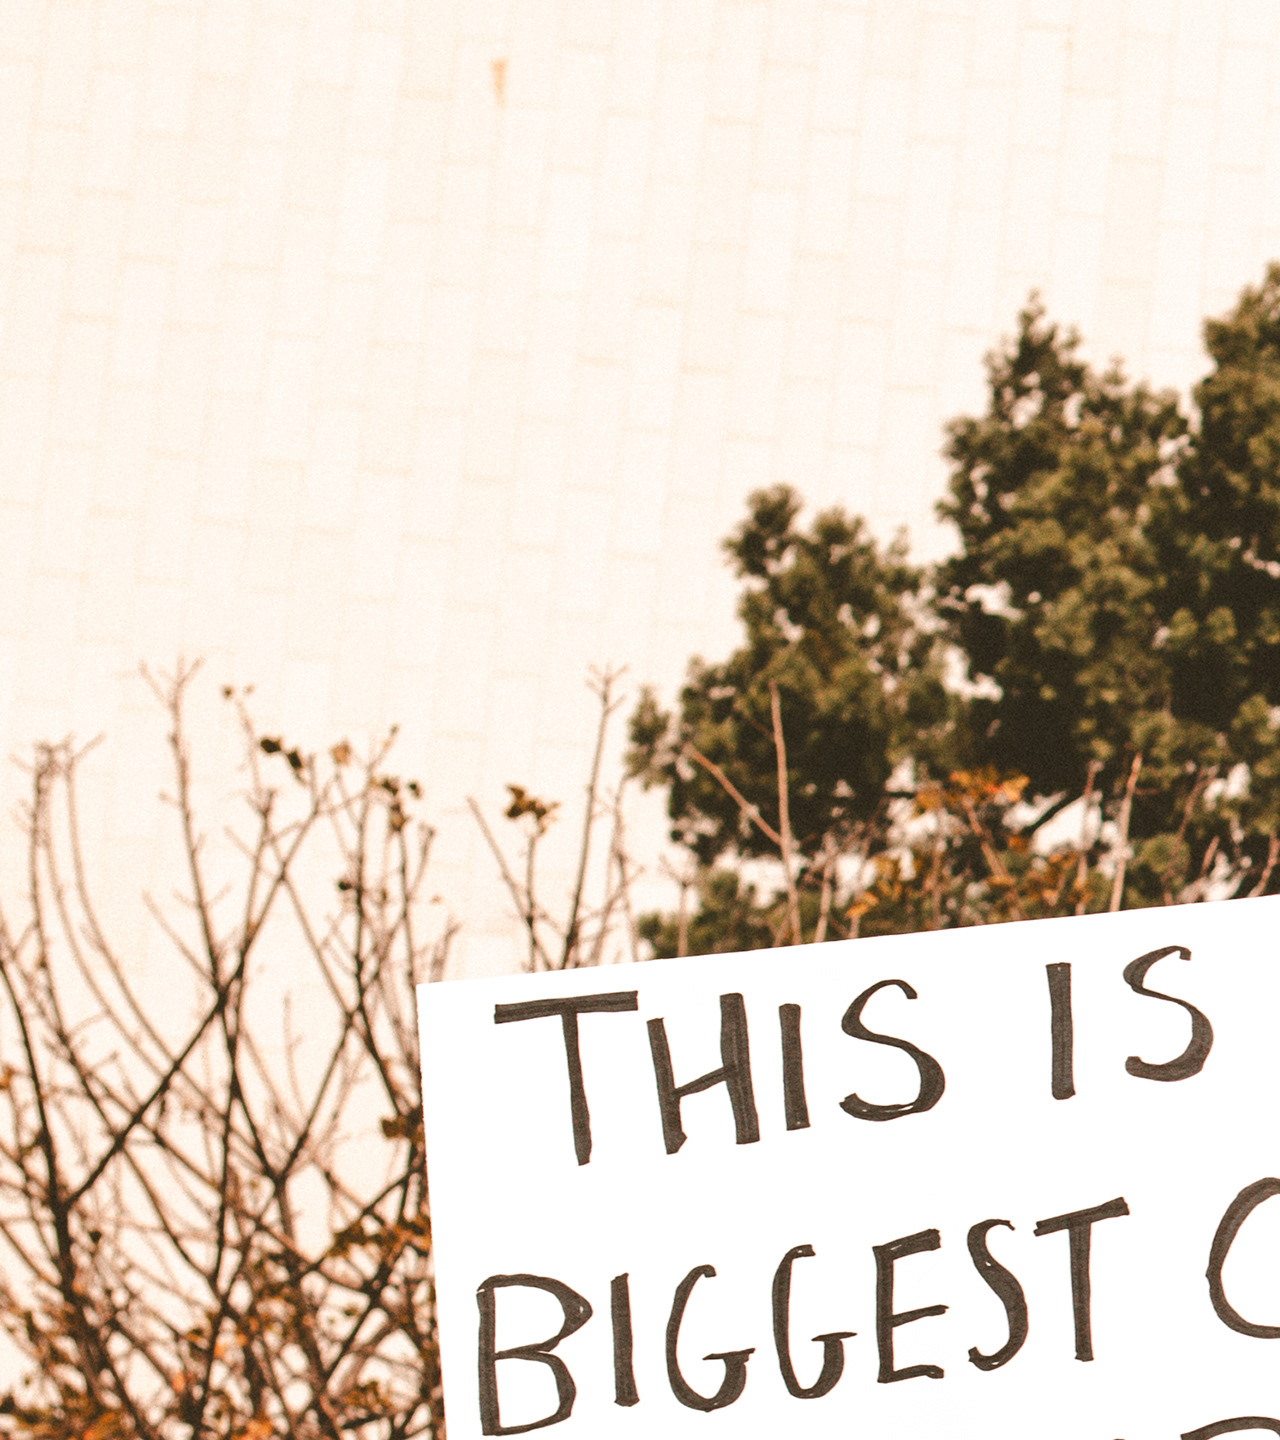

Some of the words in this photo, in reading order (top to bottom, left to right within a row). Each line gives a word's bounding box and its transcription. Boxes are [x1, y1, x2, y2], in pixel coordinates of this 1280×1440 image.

[492, 979, 946, 1167] THIS
[1045, 945, 1214, 1101] IS
[475, 1196, 1130, 1437] BIGGEST
